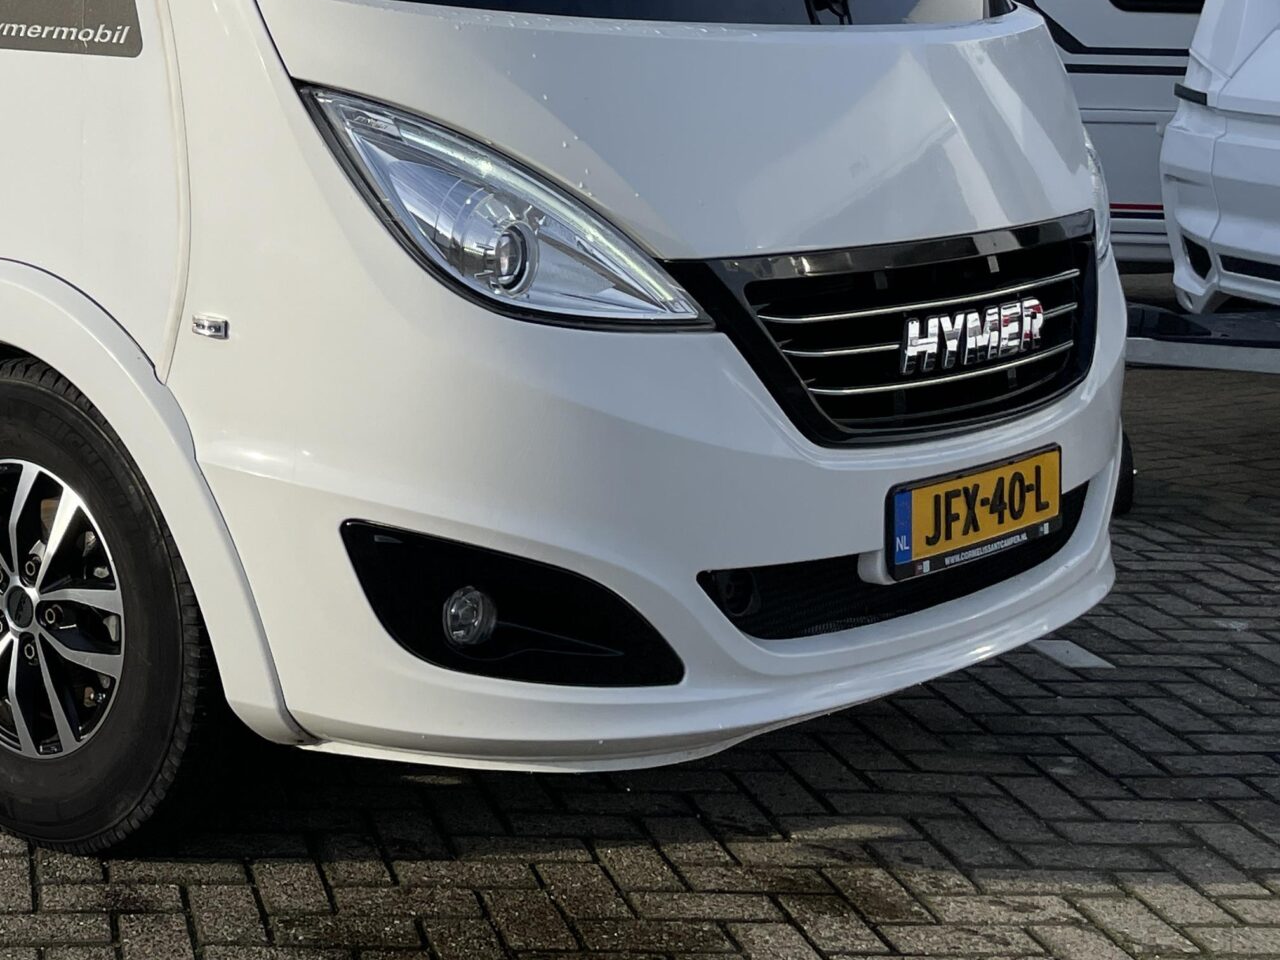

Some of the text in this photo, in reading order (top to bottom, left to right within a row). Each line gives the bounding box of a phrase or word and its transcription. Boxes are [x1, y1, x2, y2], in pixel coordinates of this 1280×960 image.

[902, 297, 1044, 375] HYMER
[896, 536, 909, 552] NL
[925, 465, 1049, 547] JFX-40-L
